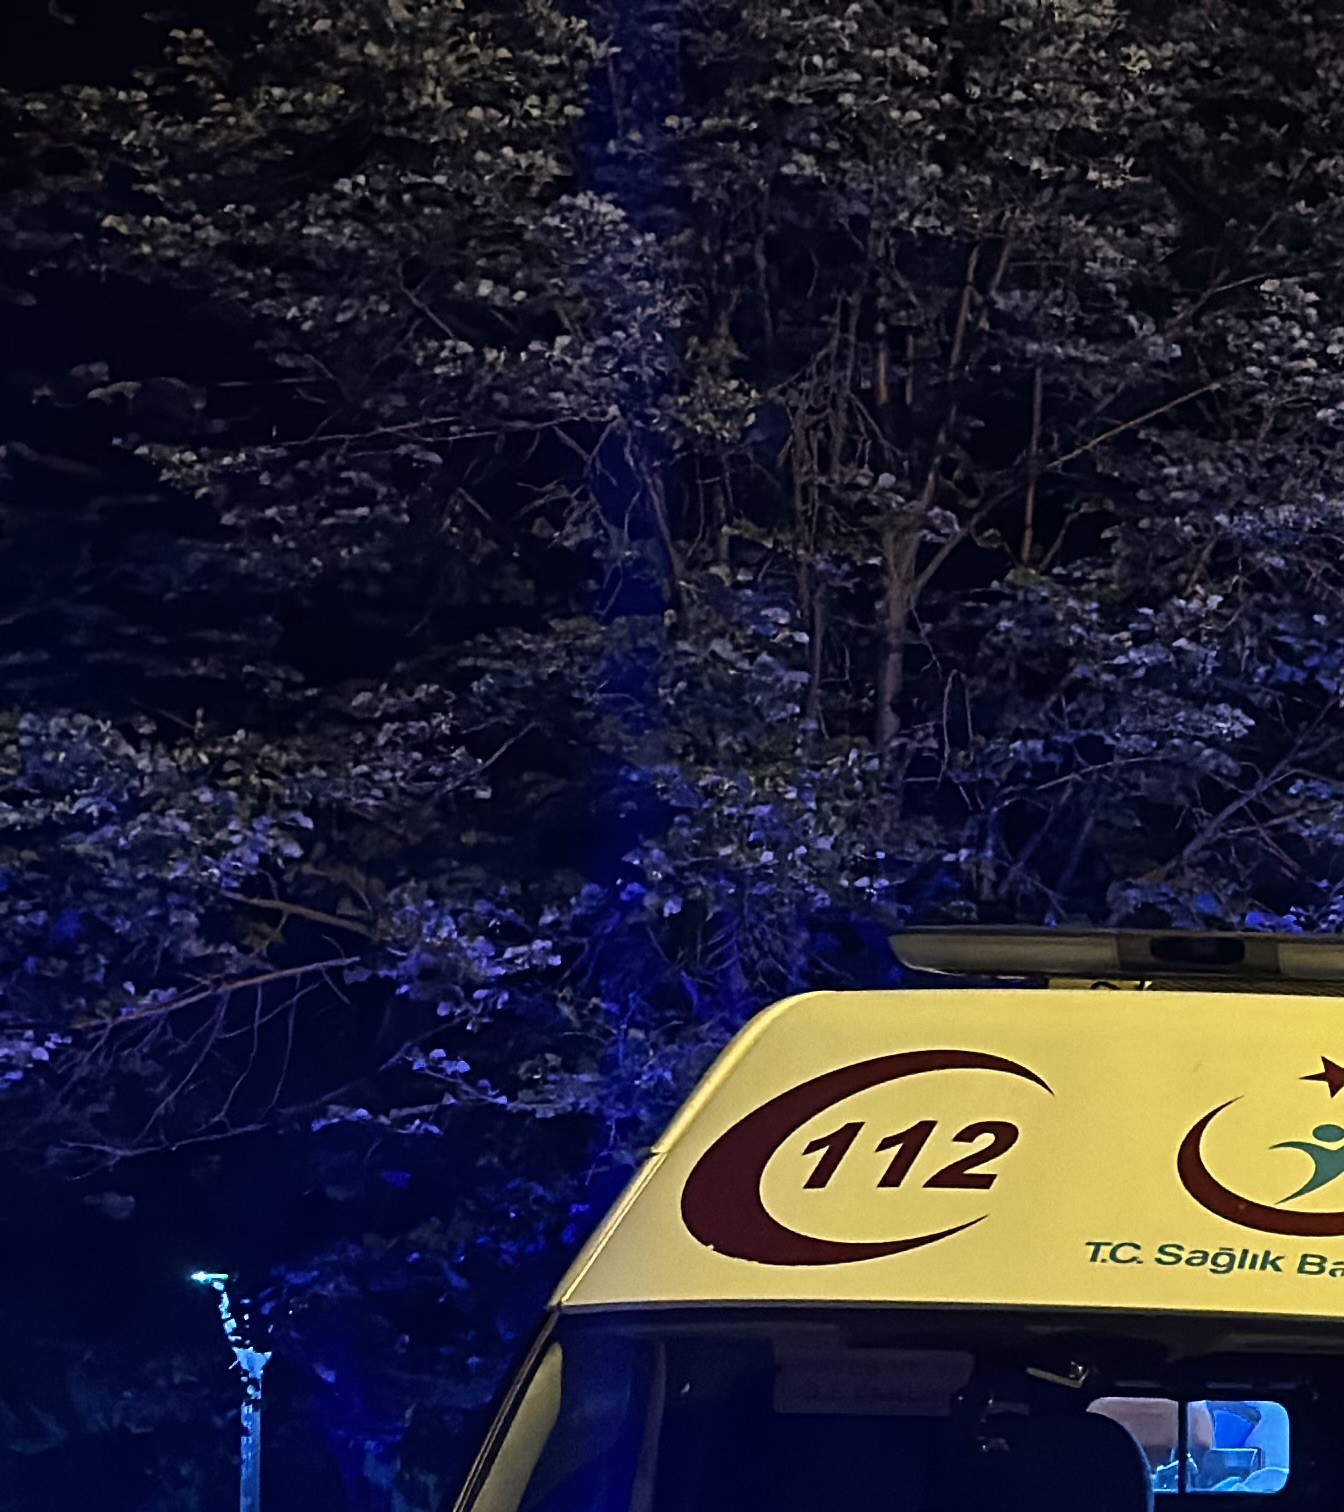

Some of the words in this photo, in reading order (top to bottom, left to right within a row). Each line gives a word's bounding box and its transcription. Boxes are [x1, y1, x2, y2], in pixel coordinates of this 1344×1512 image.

[800, 1120, 1020, 1190] 112
[1084, 1241, 1143, 1265] T.C.
[1153, 1243, 1286, 1275] Sağlık
